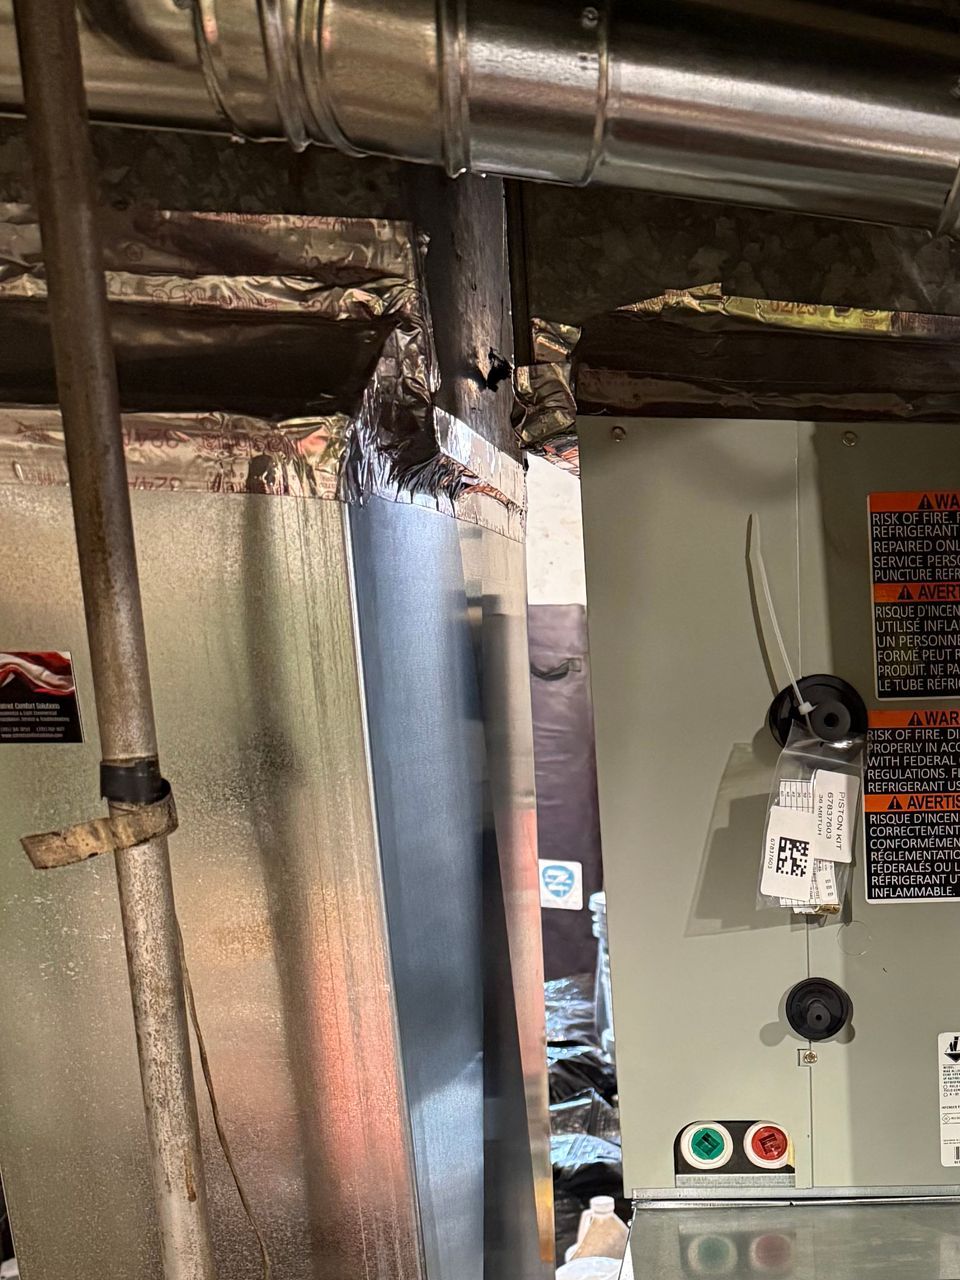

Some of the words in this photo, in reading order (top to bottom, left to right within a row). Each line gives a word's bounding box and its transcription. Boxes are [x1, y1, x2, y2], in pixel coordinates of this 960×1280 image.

[873, 514, 899, 525] RISK
[903, 513, 918, 524] OF
[924, 513, 952, 524] FIRE.
[873, 525, 959, 537] REFRIGERANT
[874, 541, 932, 552] REPAIRED
[874, 556, 923, 567] SERVICE
[875, 569, 932, 581] PUNCTURE
[876, 605, 914, 618] RISQUE
[877, 618, 920, 633] UTILISÉ
[877, 636, 895, 647] UN
[878, 647, 919, 662] FORMÉ
[923, 649, 952, 661] PEUT
[879, 665, 926, 676] PRODUIT.
[879, 679, 891, 691] LE
[894, 679, 923, 690] TUBE
[867, 730, 892, 740] RISK
[896, 730, 911, 740] OF
[916, 730, 943, 739] FIRE.
[867, 743, 922, 754] PROPERLY
[926, 743, 937, 752] IN
[868, 757, 899, 766] WITH
[904, 756, 956, 766] FEDERAL
[868, 768, 948, 779] REGULATIONS.
[868, 782, 945, 792] REFRIGERANT
[836, 791, 846, 833] PISTON
[870, 814, 910, 825] RISQUE
[870, 826, 960, 837] CORRECTEMENT
[835, 833, 843, 851] KIT
[935, 862, 950, 872] OU
[872, 887, 955, 897] INFLAMMABLE.
